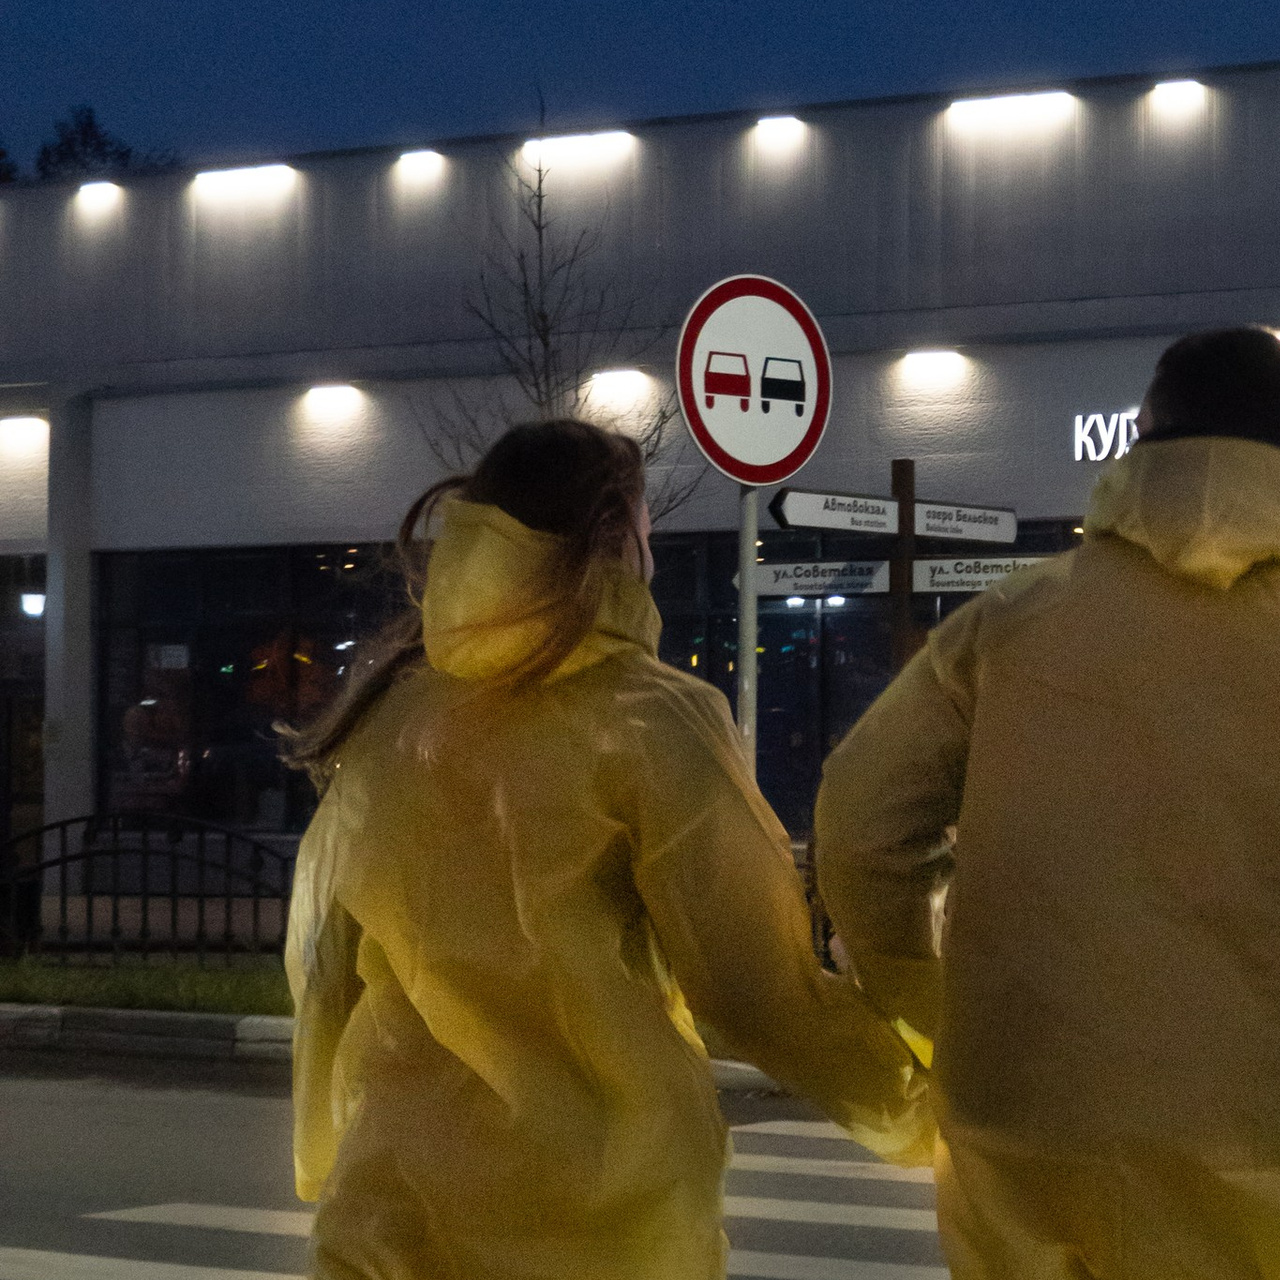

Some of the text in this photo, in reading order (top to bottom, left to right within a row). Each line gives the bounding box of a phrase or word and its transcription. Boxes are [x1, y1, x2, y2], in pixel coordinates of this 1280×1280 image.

[822, 498, 887, 516] Автовокзал
[925, 509, 953, 524] озеро
[929, 565, 950, 578] ул.
